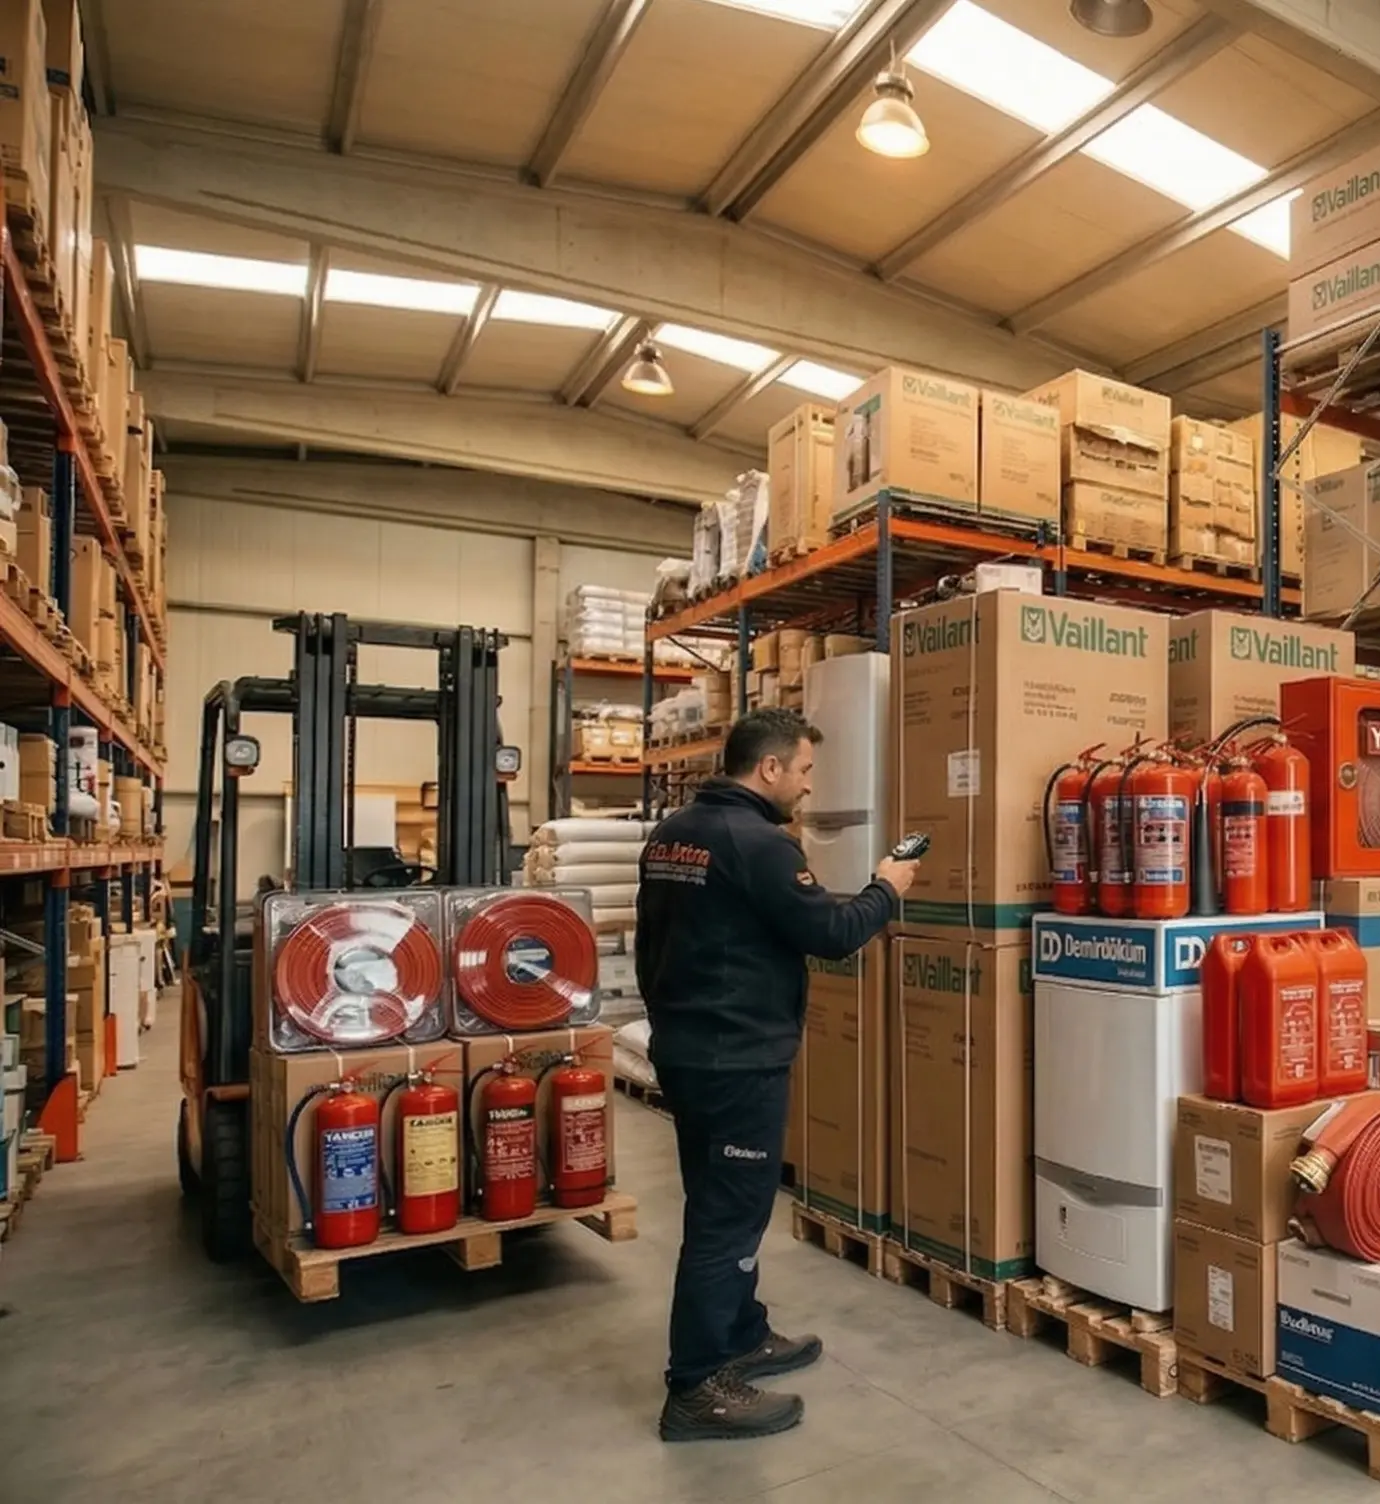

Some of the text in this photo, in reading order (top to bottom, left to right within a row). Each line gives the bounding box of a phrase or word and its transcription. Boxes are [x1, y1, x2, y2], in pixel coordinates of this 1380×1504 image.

[1049, 609, 1149, 659] Vaillant
[1254, 629, 1339, 673] Vaillant
[917, 953, 982, 997] Vaillant
